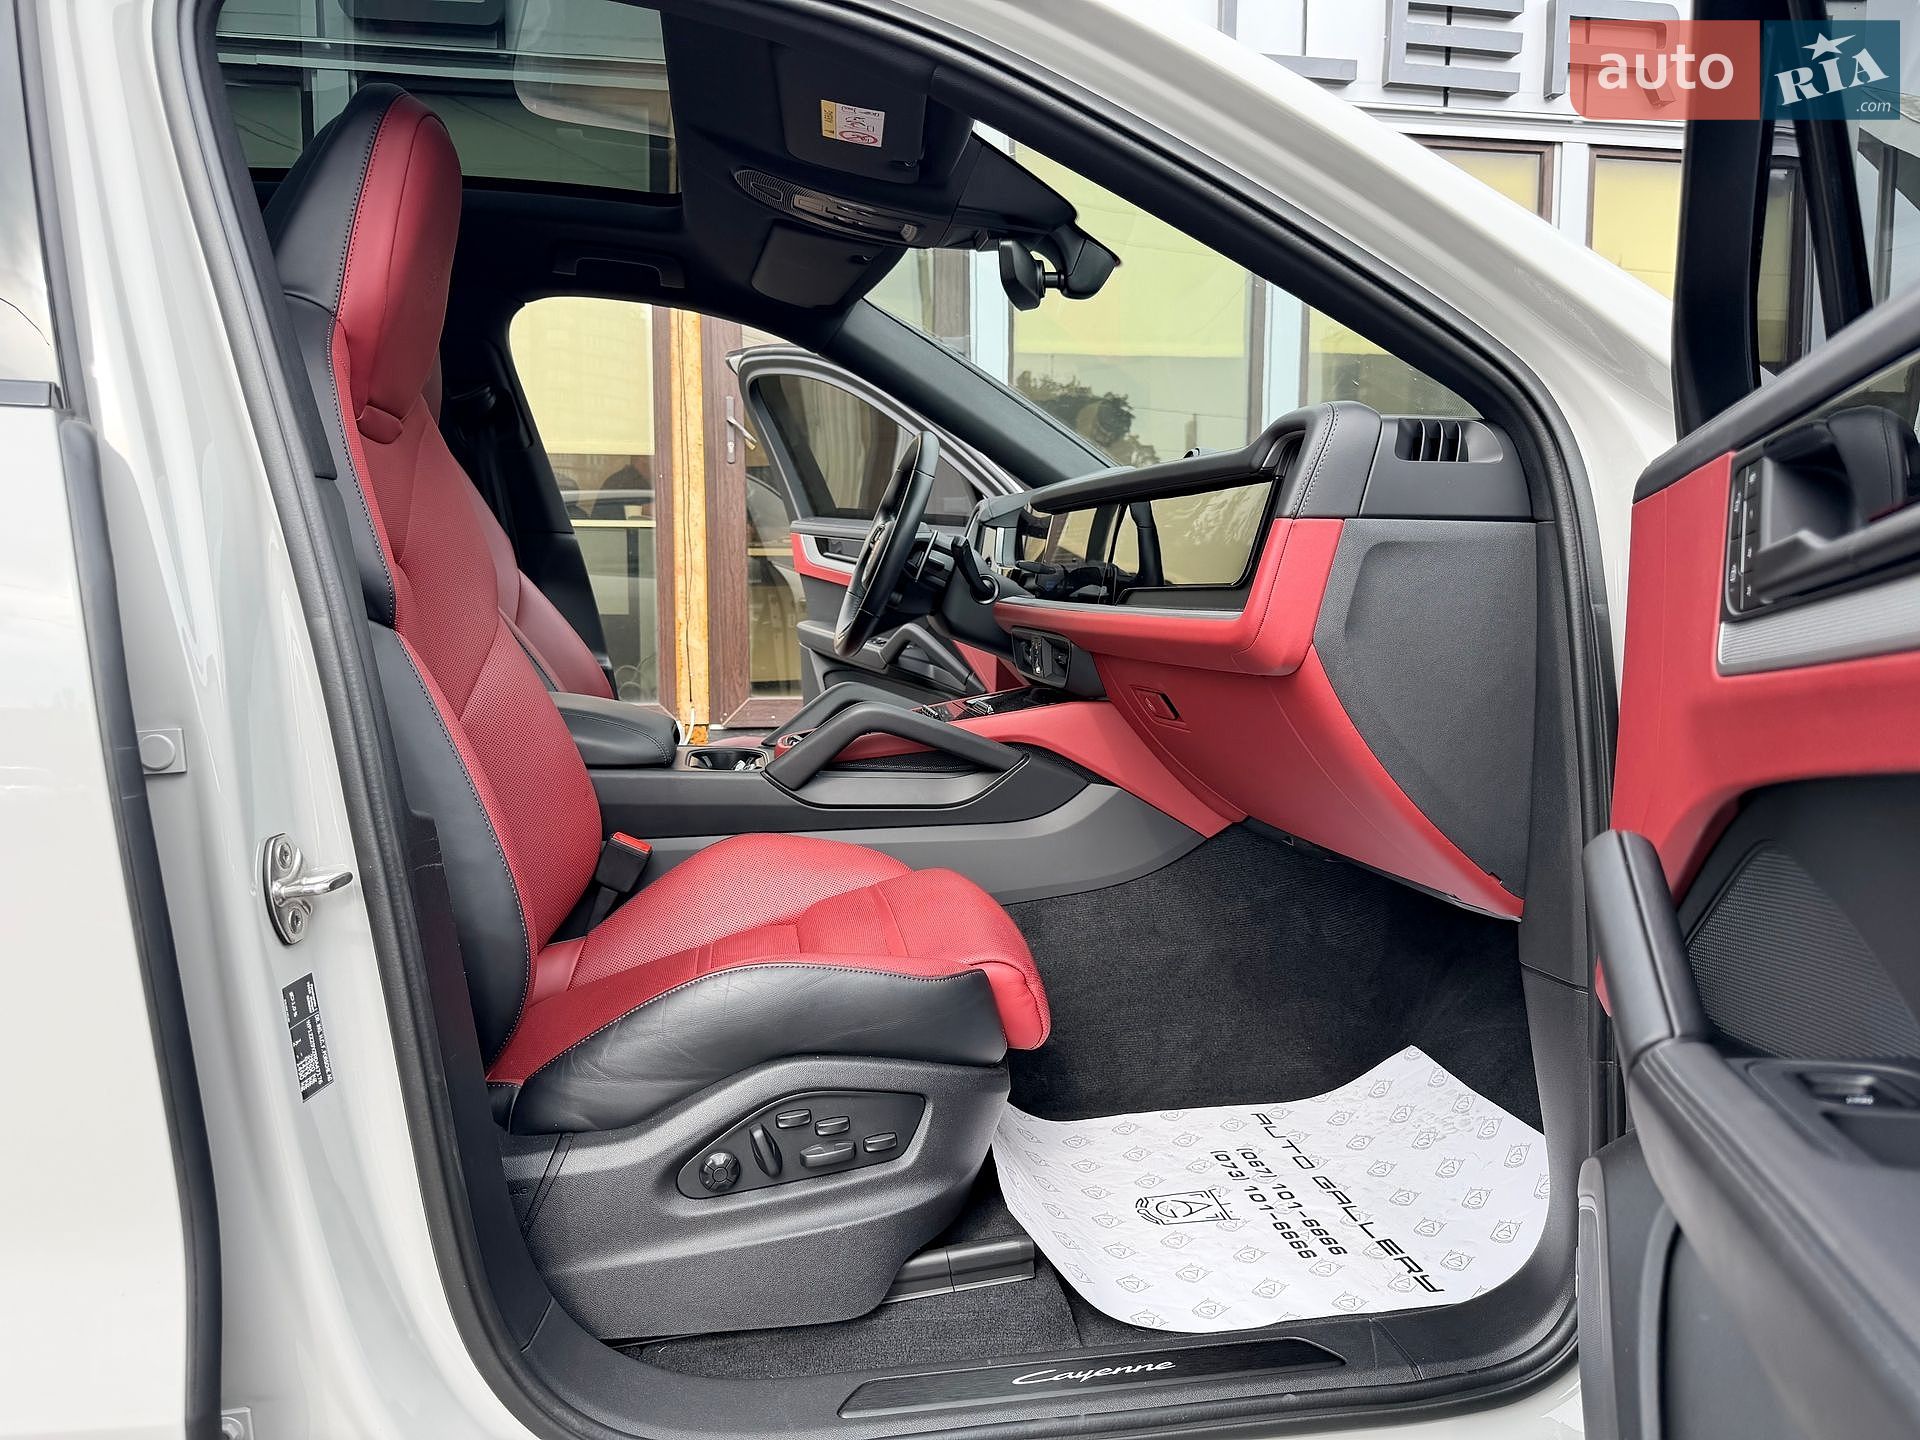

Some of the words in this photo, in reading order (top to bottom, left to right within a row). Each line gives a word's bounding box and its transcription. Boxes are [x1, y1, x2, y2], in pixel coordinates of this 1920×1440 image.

[1210, 1150, 1250, 1182] (073)
[1244, 1185, 1317, 1260] 101-6666
[1236, 1147, 1278, 1178] (067)
[1272, 1183, 1348, 1255] 101-6666
[1251, 1113, 1315, 1170] AUTO
[1312, 1175, 1445, 1293] GALLERY
[1011, 1361, 1177, 1385] Cayenne
